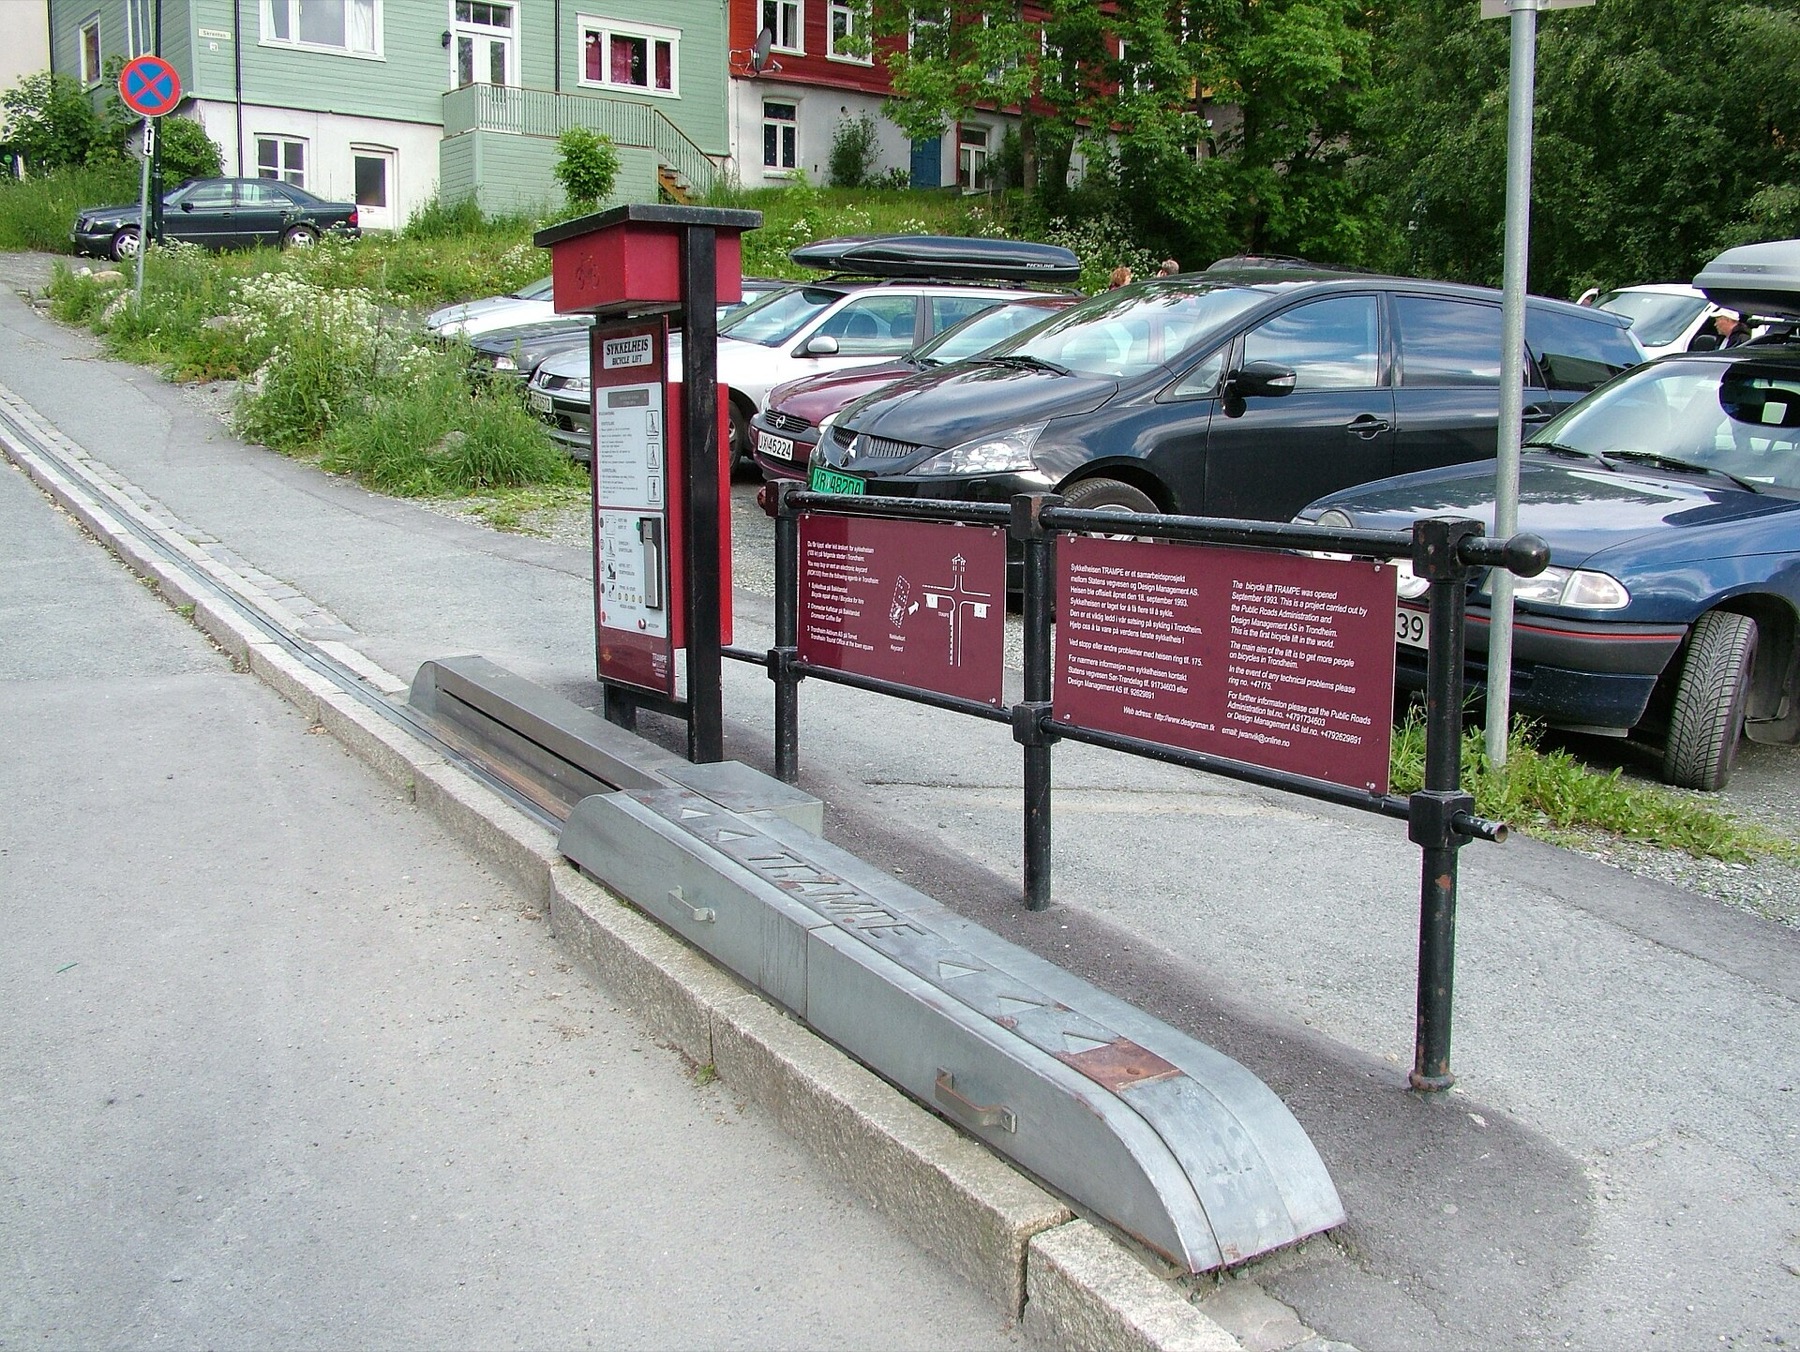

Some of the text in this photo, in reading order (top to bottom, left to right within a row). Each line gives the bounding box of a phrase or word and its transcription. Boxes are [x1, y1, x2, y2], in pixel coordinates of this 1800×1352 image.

[606, 339, 648, 355] SYKKELHEIS
[612, 355, 642, 365] BICYCLE LIFT
[1233, 580, 1243, 589] The
[1246, 582, 1265, 592] bicycle
[1275, 585, 1300, 595] TRAMPE
[1232, 592, 1262, 602] September
[1262, 596, 1278, 604] 1993.
[1281, 597, 1292, 606] This
[1293, 599, 1298, 607] is
[1304, 602, 1325, 610] project
[1359, 607, 1368, 617] by
[1241, 605, 1258, 614] Public
[1259, 607, 1278, 616] Roads
[1278, 610, 1319, 621] Administration
[1231, 616, 1337, 636] Design Management AS in Trondheim.
[1396, 612, 1424, 642] 39
[1231, 626, 1242, 634] This
[1249, 629, 1258, 637] the
[1259, 630, 1270, 638] first
[1271, 632, 1290, 642] bicycle
[1306, 637, 1316, 645] the
[1317, 640, 1334, 648] world.
[1231, 641, 1241, 649] The
[1256, 645, 1267, 653] aim
[1274, 648, 1284, 656] the
[1292, 650, 1298, 658] is
[1306, 654, 1316, 662] get
[1333, 659, 1354, 667] people
[1238, 653, 1260, 662] bicycles
[1261, 655, 1266, 663] in
[1268, 657, 1298, 668] Trondheim.
[1228, 676, 1239, 686] ring
[1251, 681, 1272, 690] +47175.
[1267, 671, 1279, 682] any
[1279, 675, 1306, 684] technical
[1306, 680, 1334, 689] problems
[1335, 684, 1356, 693] please
[1227, 702, 1266, 714] Administration
[1267, 709, 1284, 718] tel.no.
[1228, 691, 1237, 699] For
[1237, 693, 1256, 702] further
[1288, 703, 1307, 712] please
[1319, 708, 1329, 716] the
[1331, 710, 1350, 720] Public
[1350, 714, 1371, 724] Roads
[1234, 713, 1253, 723] Design
[1254, 717, 1290, 729] Management
[1290, 724, 1300, 732] AS
[1300, 726, 1318, 735] tel.no.
[748, 851, 928, 938] TRAMPE
